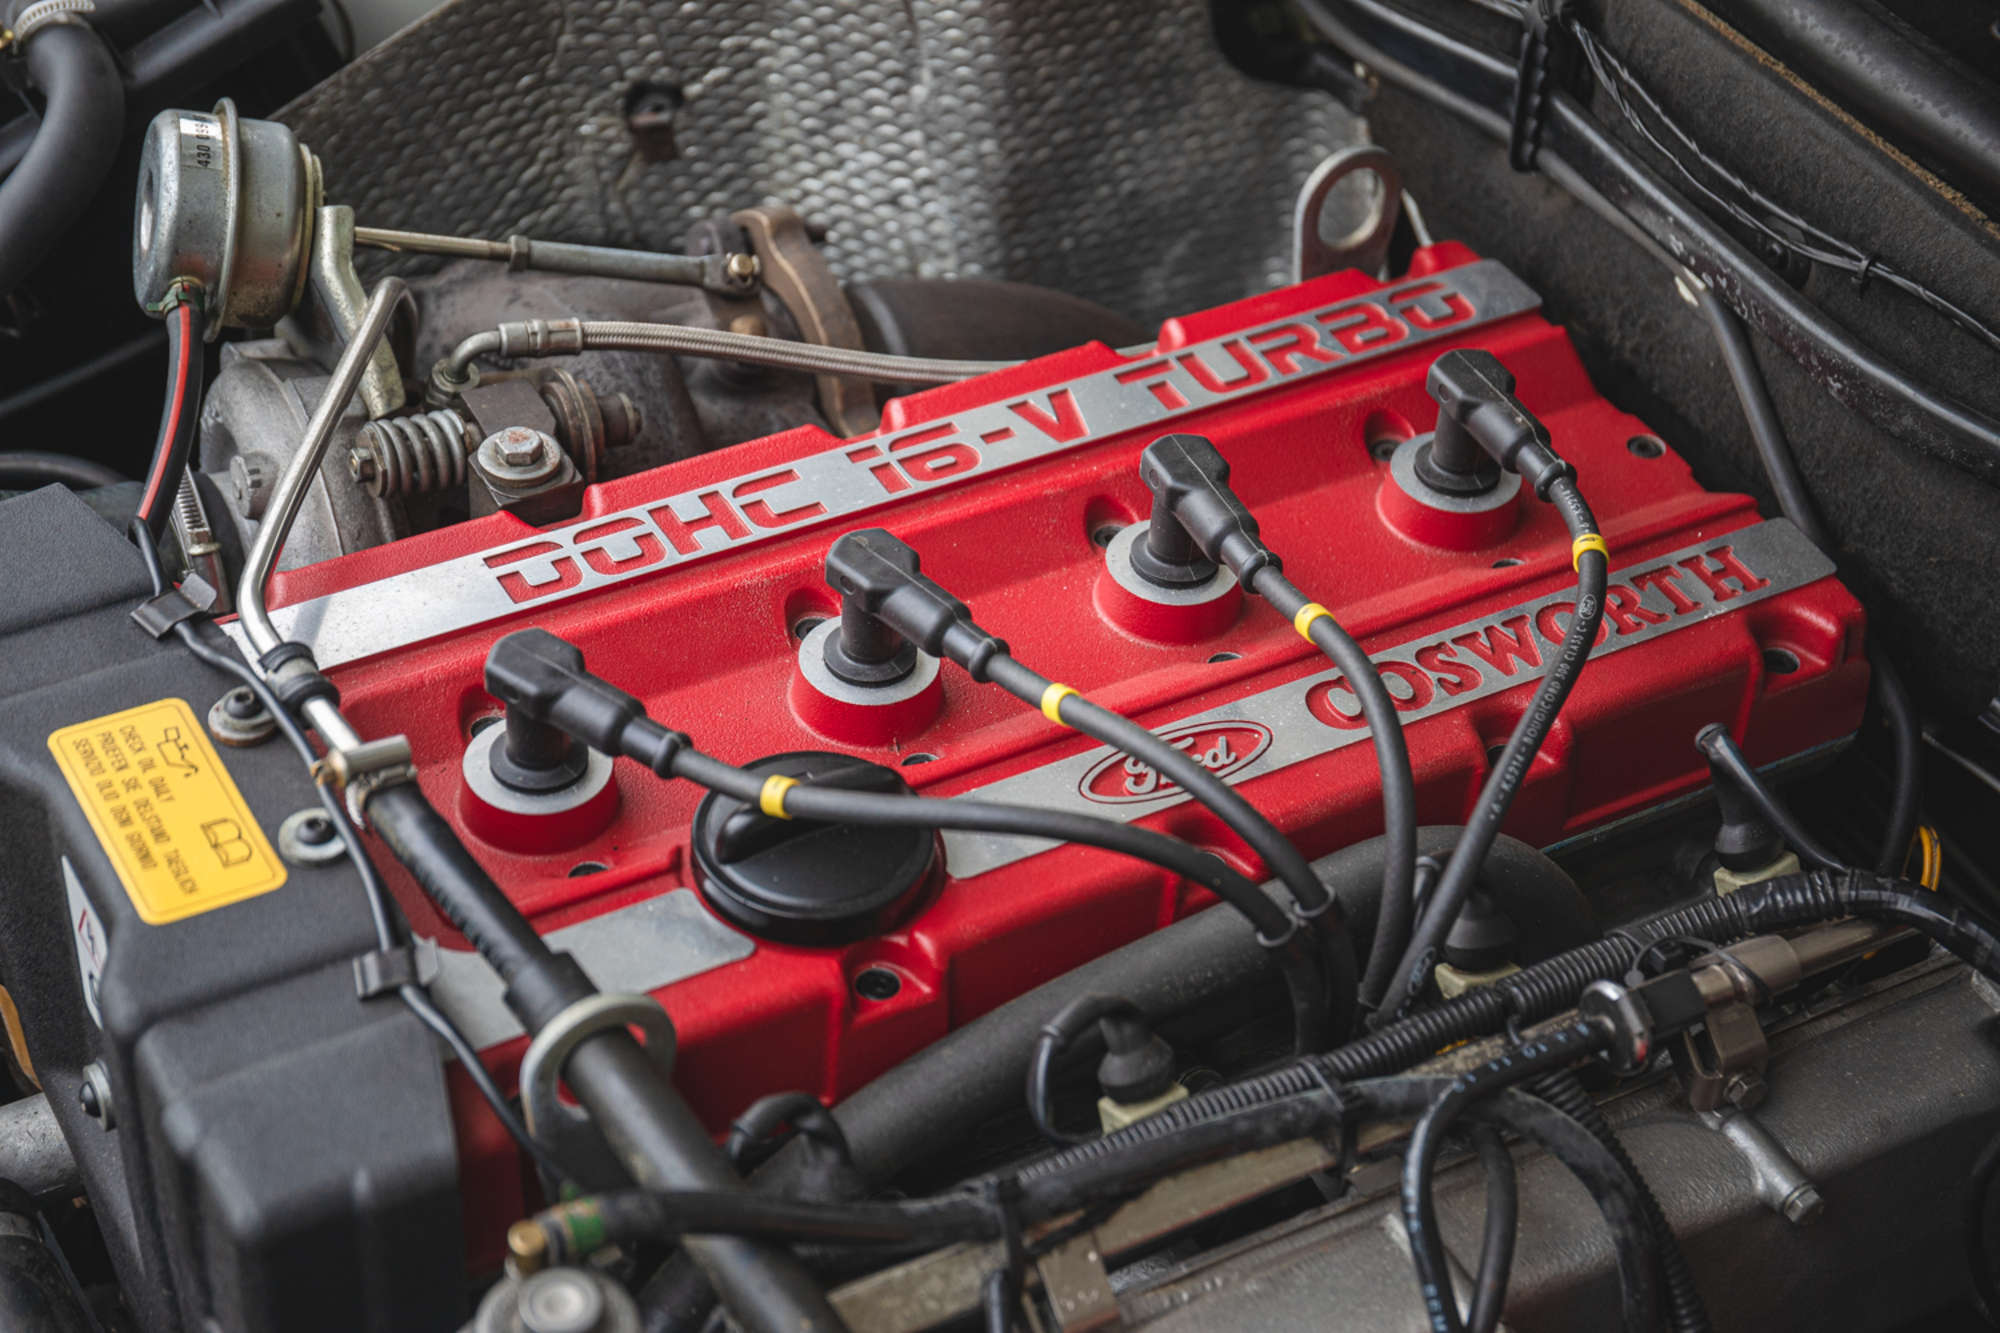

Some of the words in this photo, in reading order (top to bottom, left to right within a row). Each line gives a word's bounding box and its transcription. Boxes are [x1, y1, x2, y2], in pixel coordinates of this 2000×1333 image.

[484, 468, 829, 605] DOHC
[1114, 280, 1476, 412] TURBO
[95, 778, 121, 803] OLIO
[96, 731, 129, 773] PRUEFEN
[121, 775, 143, 794] SIE
[118, 724, 147, 755] CHECK
[138, 756, 158, 775] OIL
[148, 776, 176, 803] DAILY
